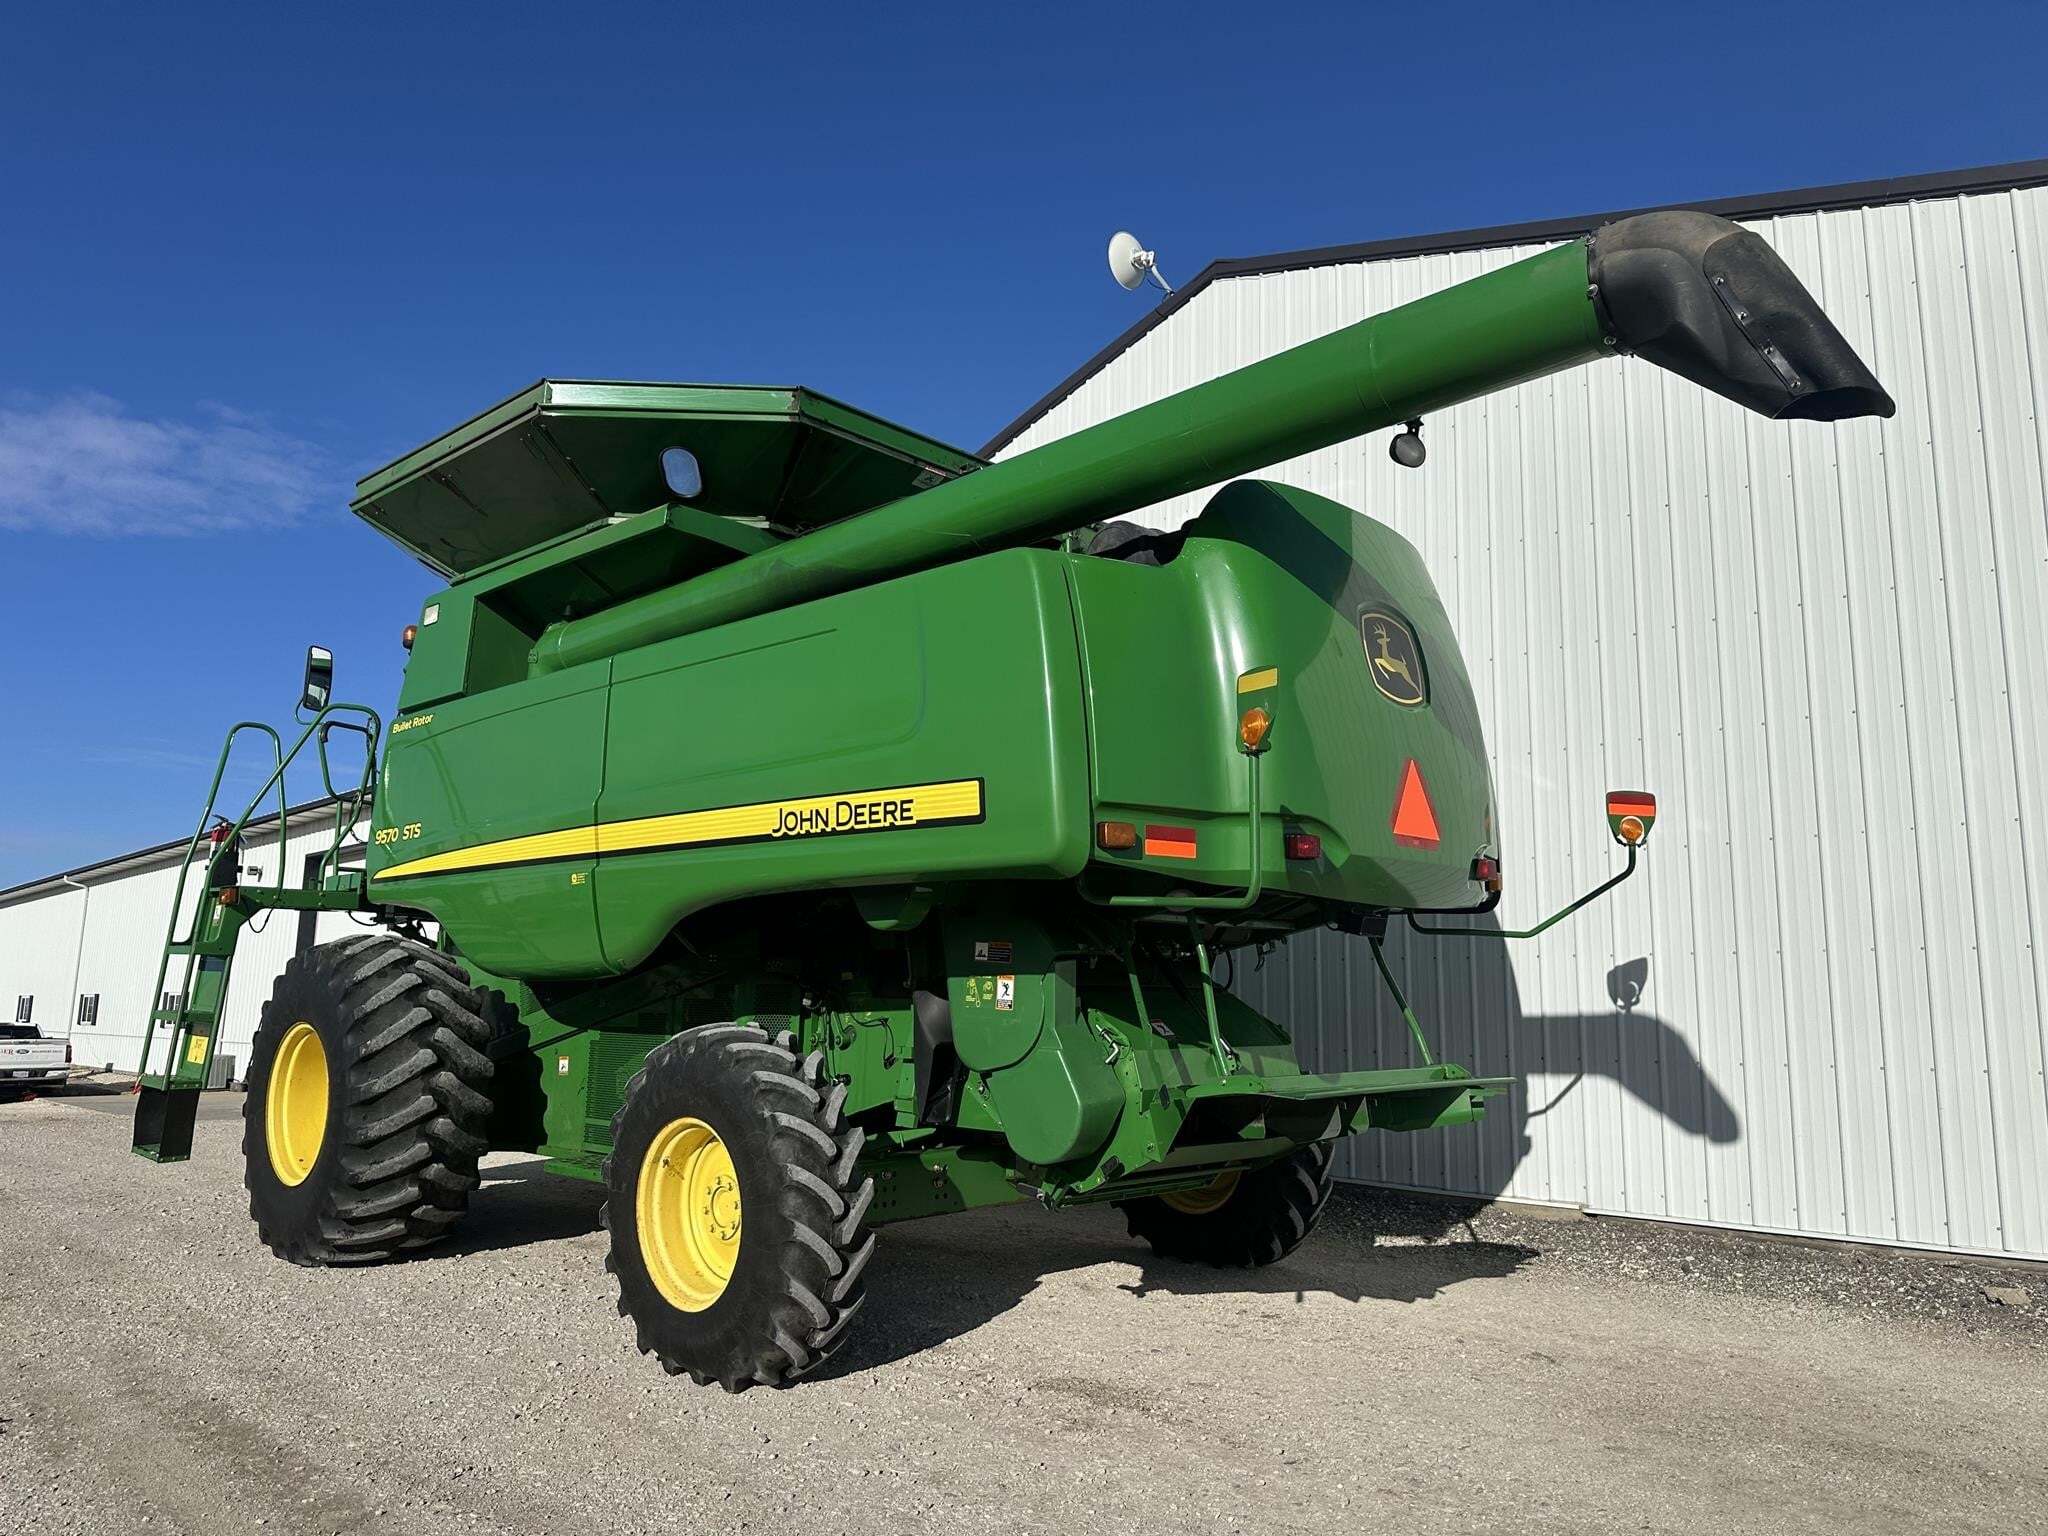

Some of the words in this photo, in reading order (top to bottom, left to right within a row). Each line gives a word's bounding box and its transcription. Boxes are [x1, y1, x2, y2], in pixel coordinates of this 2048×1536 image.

[392, 719, 412, 734] Bullet
[412, 714, 434, 728] Rotor
[772, 807, 829, 834] JOHN
[836, 799, 915, 827] DEERE
[375, 827, 399, 845] 9570
[402, 822, 422, 840] STS
